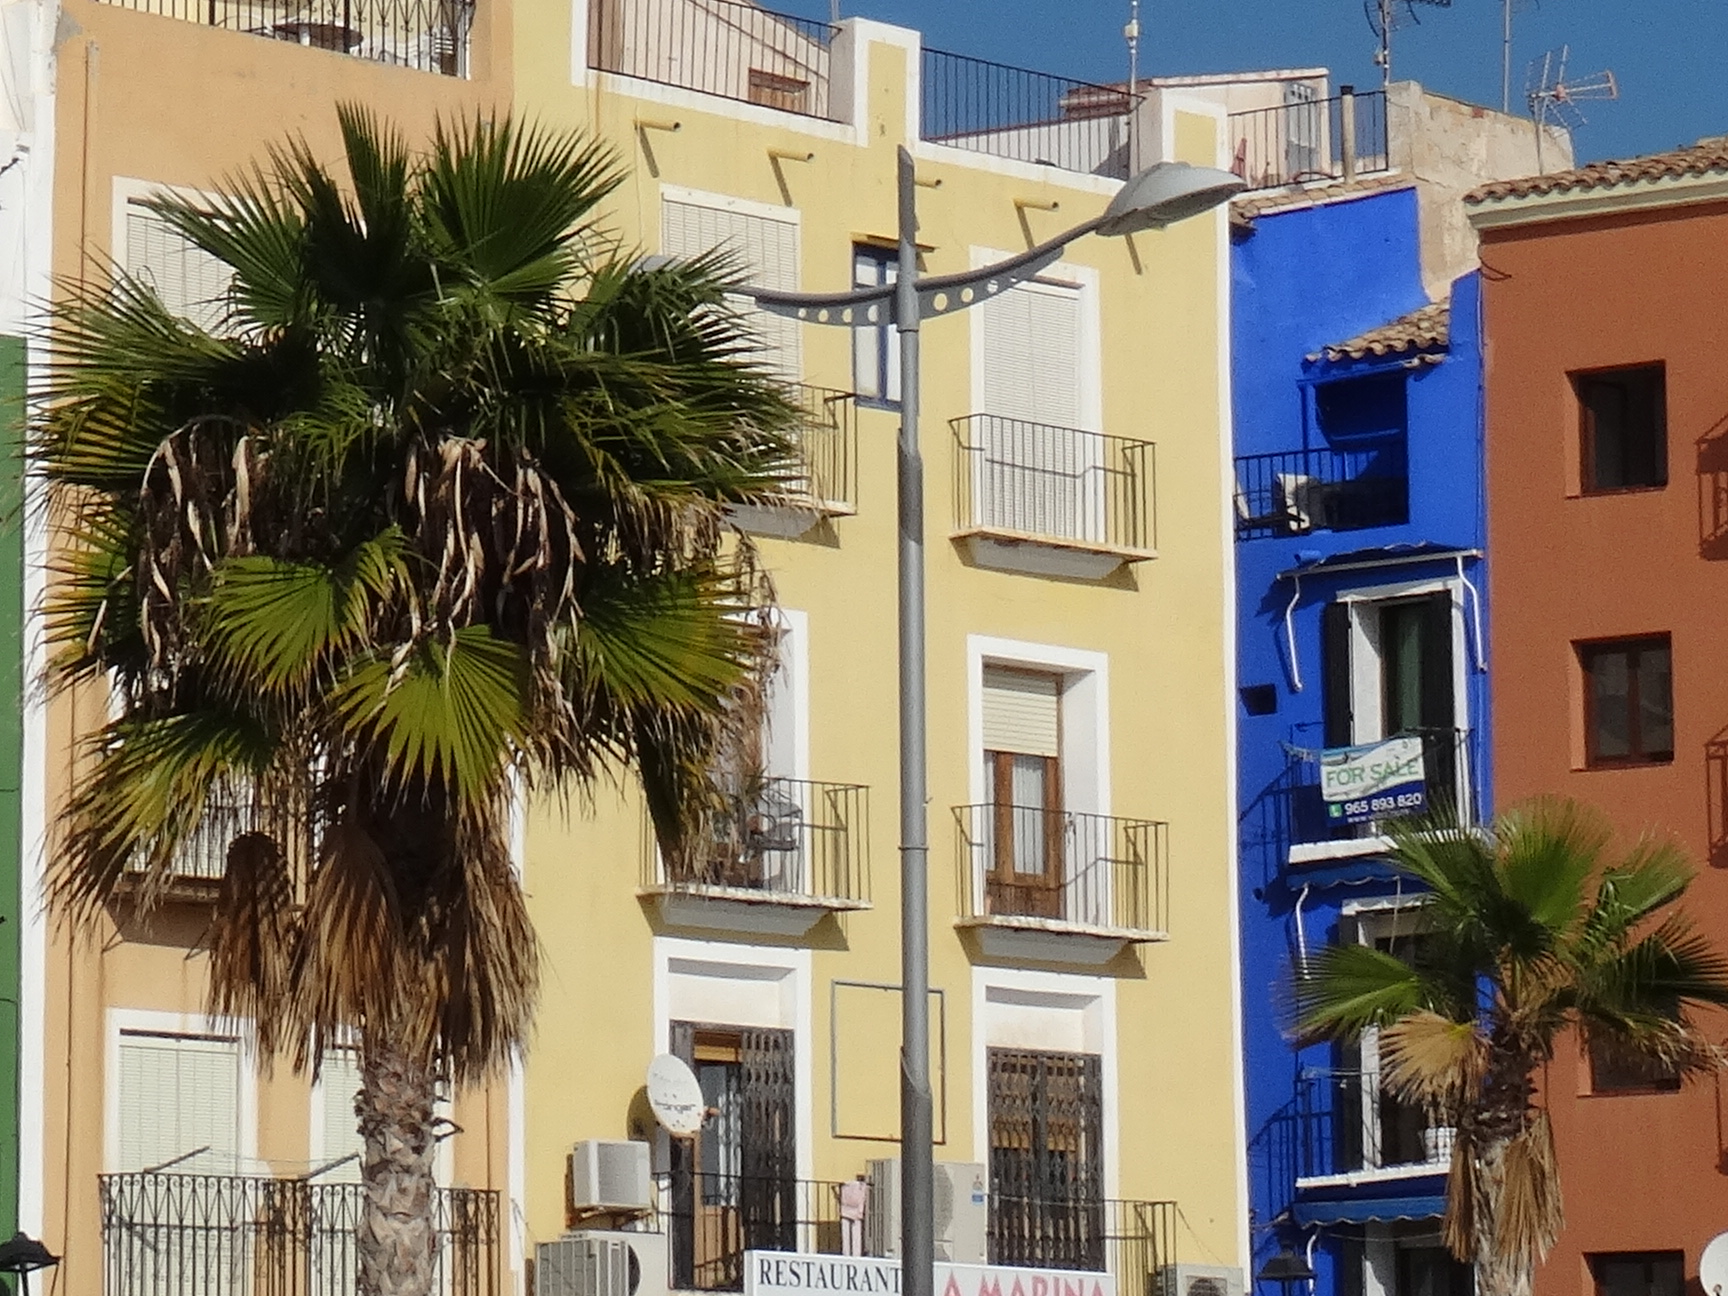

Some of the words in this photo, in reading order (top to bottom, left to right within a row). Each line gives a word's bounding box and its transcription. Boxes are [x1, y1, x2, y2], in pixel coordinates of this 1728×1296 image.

[1326, 765, 1365, 788] FOR
[1370, 760, 1419, 781] SALE
[1344, 801, 1369, 816] 965
[1371, 796, 1394, 811] 893
[1397, 792, 1422, 807] 820
[759, 1258, 903, 1294] RESTAURANT
